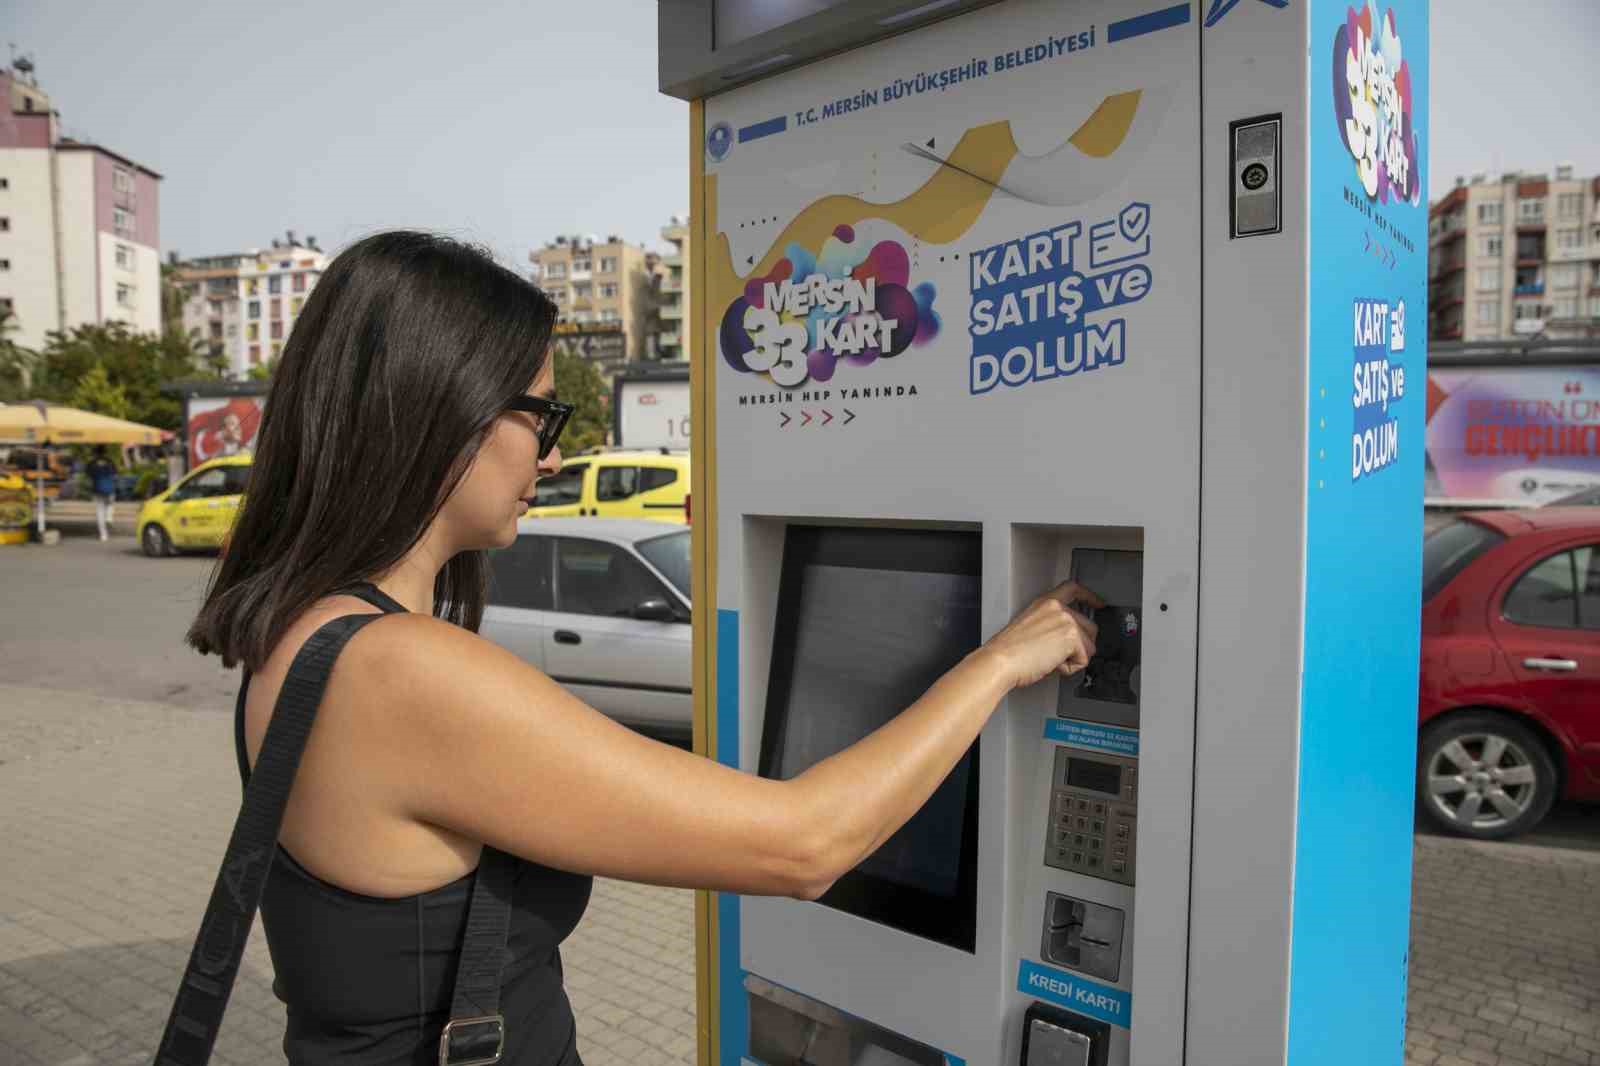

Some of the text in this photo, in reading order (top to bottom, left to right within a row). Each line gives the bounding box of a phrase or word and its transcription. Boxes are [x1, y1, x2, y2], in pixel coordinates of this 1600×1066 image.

[796, 25, 1096, 126] T.C. MERSİN BÜYÜKŞEHİR BELEDİYESİ
[972, 225, 1079, 290] KART
[763, 266, 876, 316] MERSİN
[971, 268, 1149, 337] SATIŞ ve
[742, 305, 809, 387] 33
[816, 313, 899, 356] KART
[1353, 302, 1389, 347] KART
[972, 322, 1123, 392] DOLUM
[738, 384, 919, 406] MERSİN HEP YANINDA
[1352, 359, 1404, 413] SATIŞ ve
[1352, 419, 1399, 479] DOLUM
[1028, 971, 1121, 1015] KREDİ KARTI
